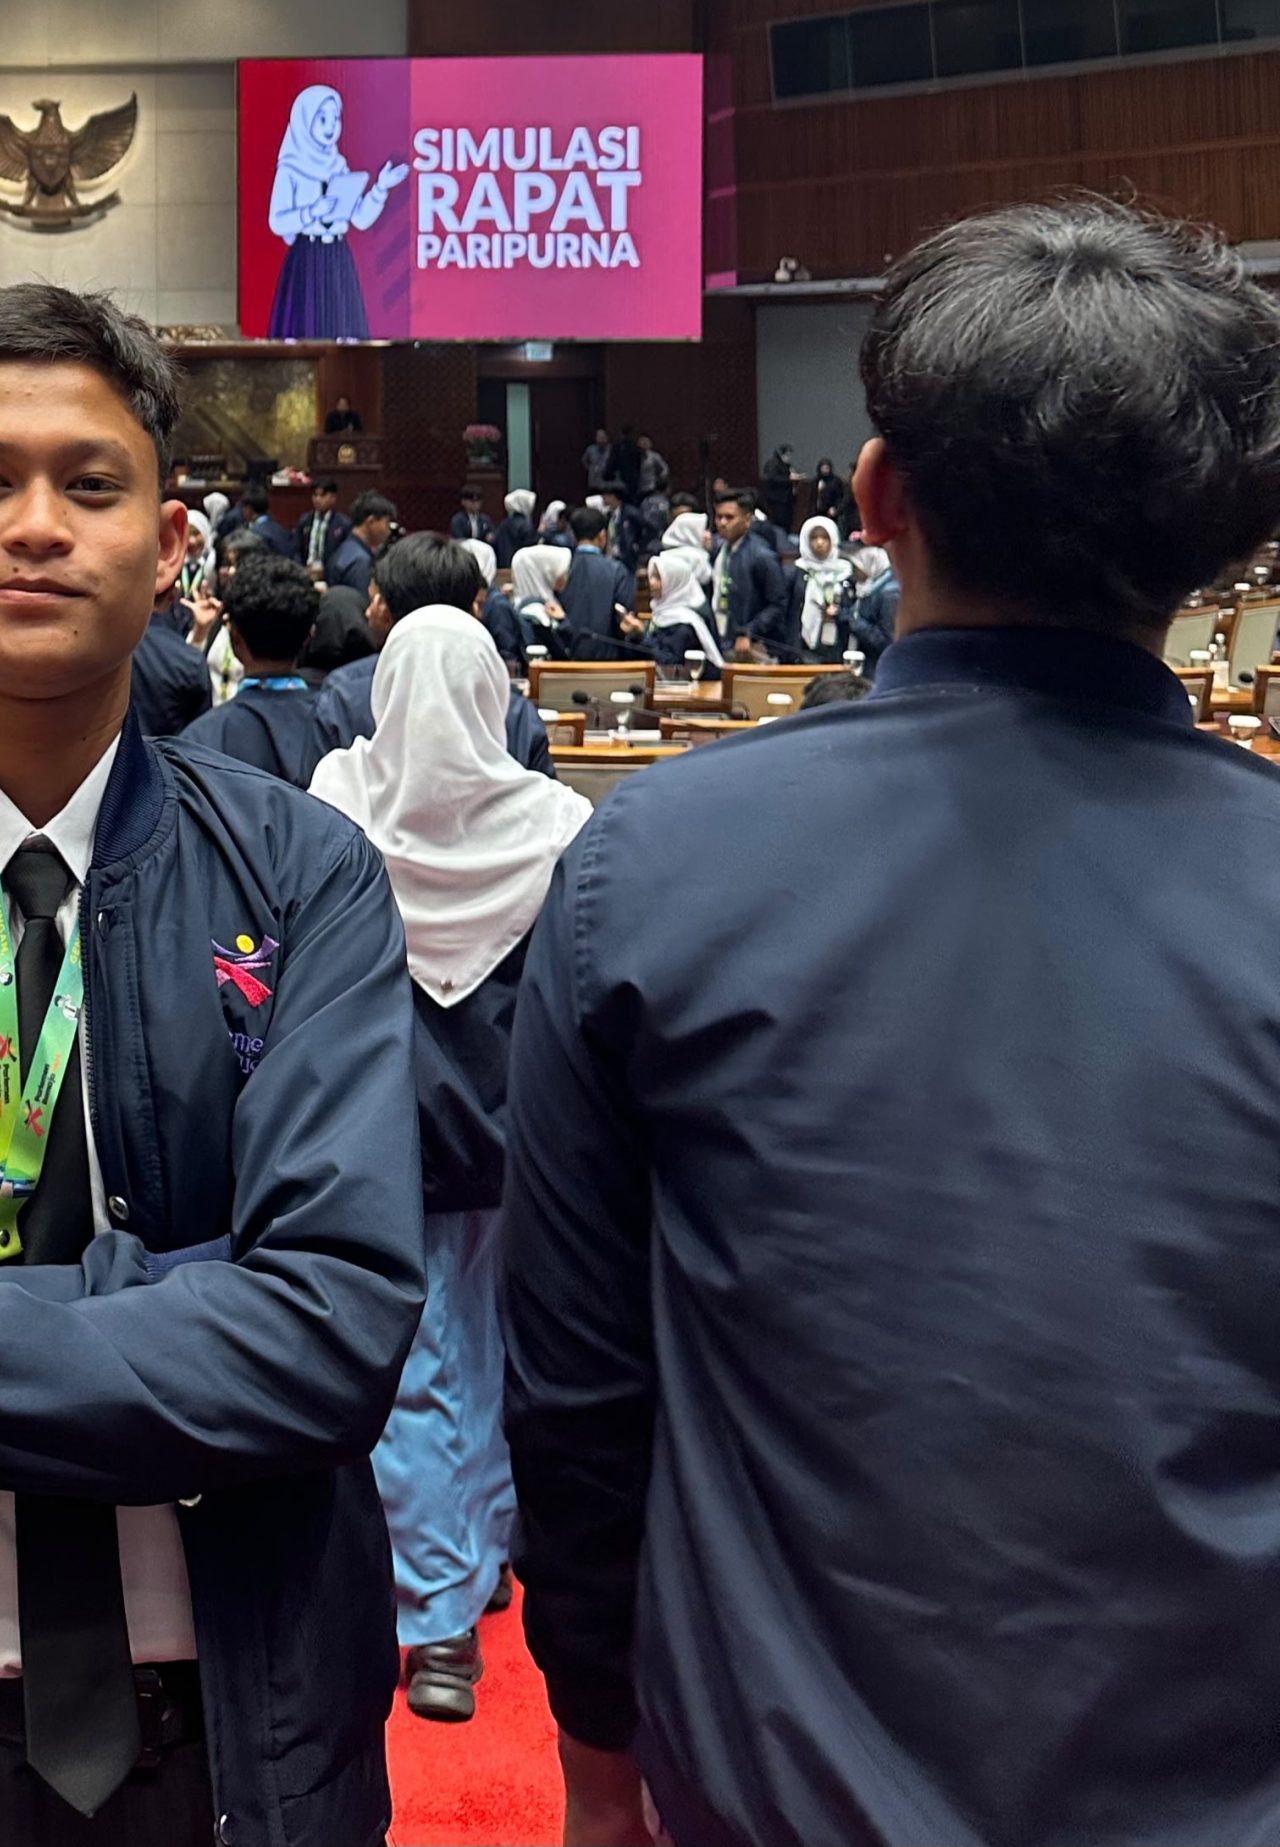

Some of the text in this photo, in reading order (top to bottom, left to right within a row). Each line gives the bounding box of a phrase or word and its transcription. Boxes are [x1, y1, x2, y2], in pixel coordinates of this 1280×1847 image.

[412, 126, 640, 172] SIMULASI
[418, 171, 642, 233] RAPAT
[417, 232, 640, 269] PARIPURNA
